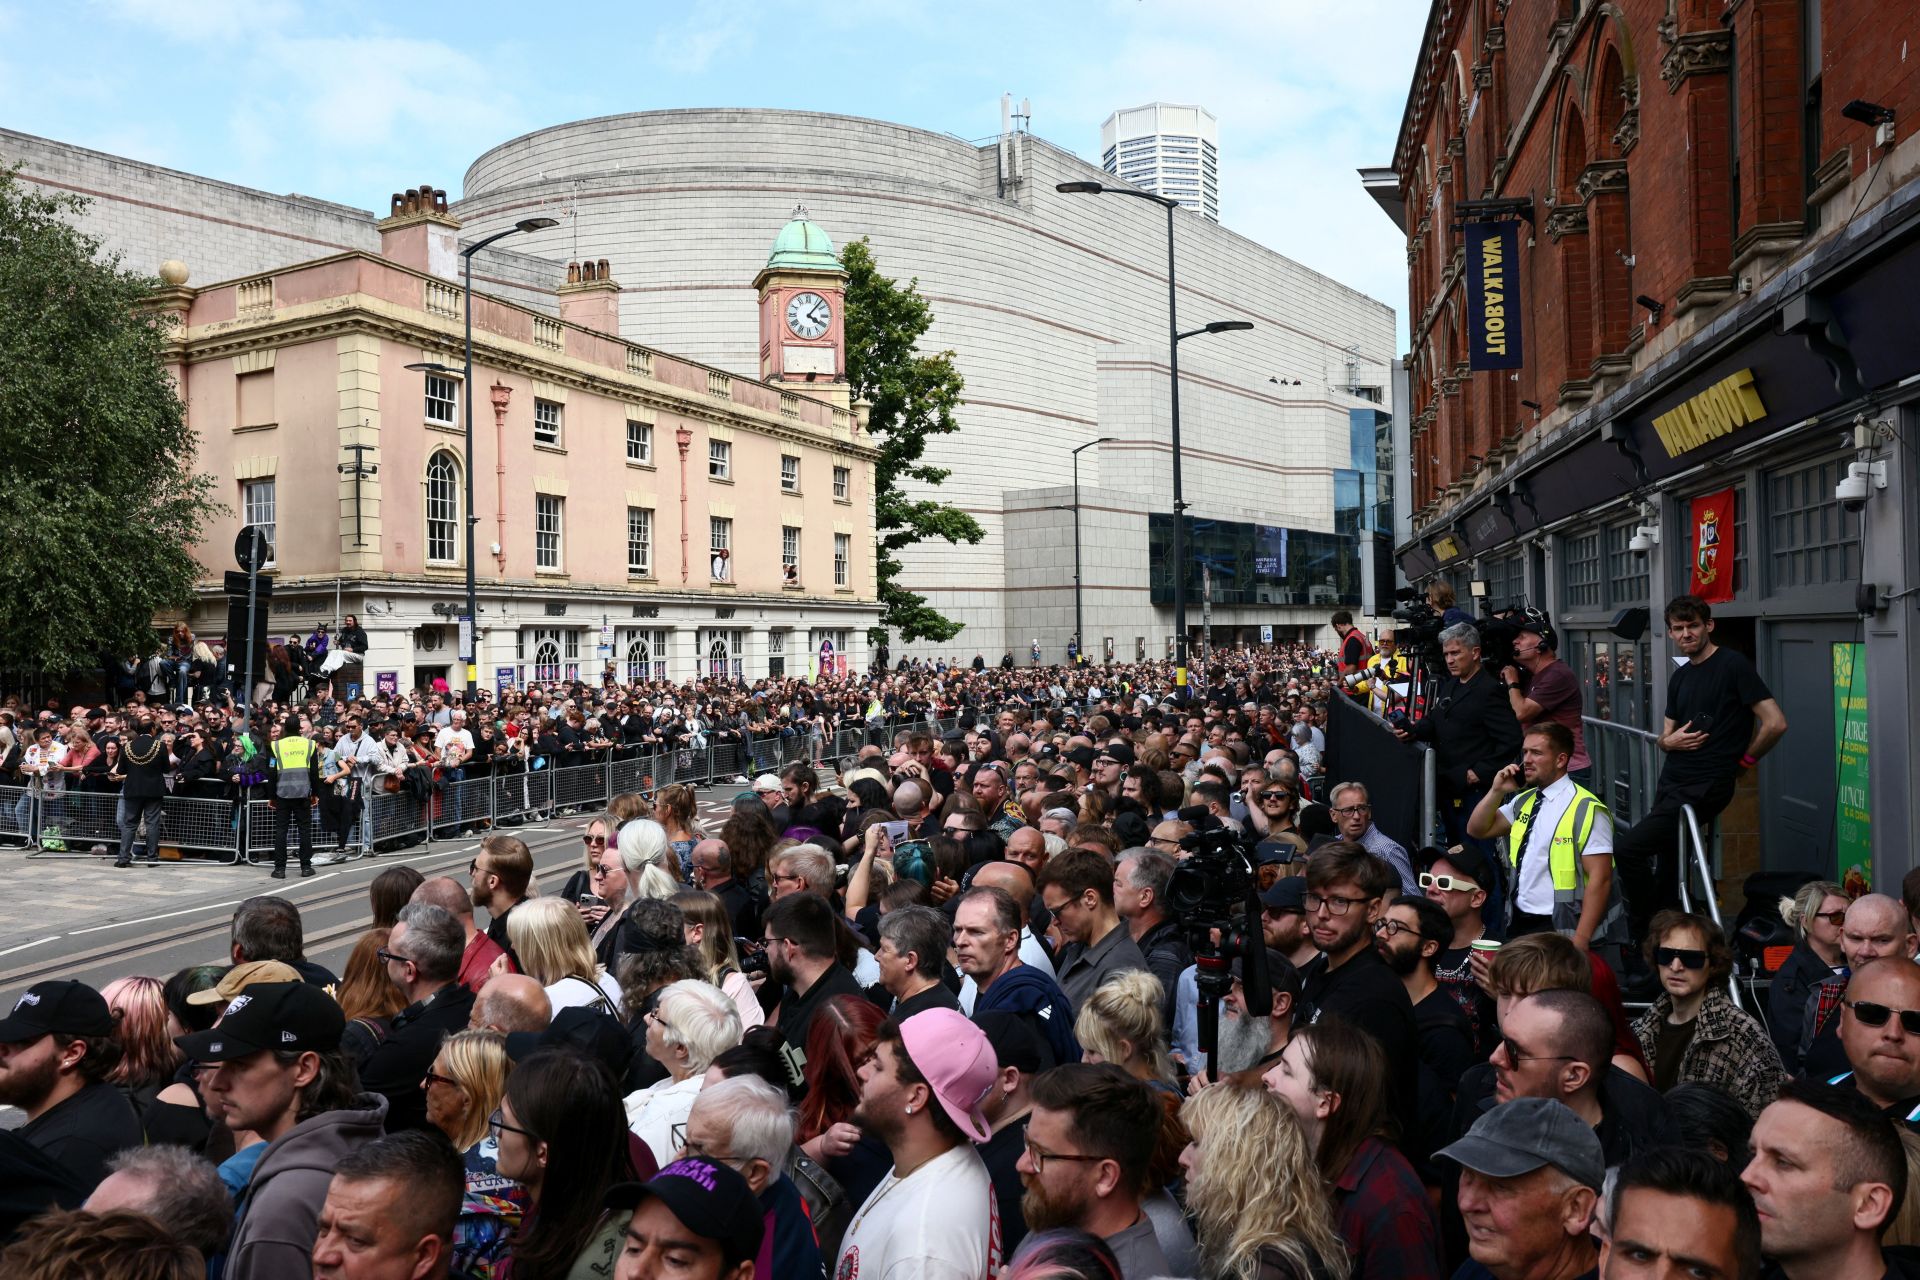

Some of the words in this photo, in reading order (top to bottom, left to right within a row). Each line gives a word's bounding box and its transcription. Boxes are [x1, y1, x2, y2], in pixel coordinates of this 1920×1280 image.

[1483, 235, 1506, 355] WALKABOUT
[1651, 367, 1767, 459] WALKABOUT
[379, 681, 394, 690] 50%
[1841, 697, 1868, 710] WALKABOU
[1844, 720, 1868, 742] BURGE
[1840, 785, 1865, 809] LUNCH
[1855, 811, 1870, 823] DRIN
